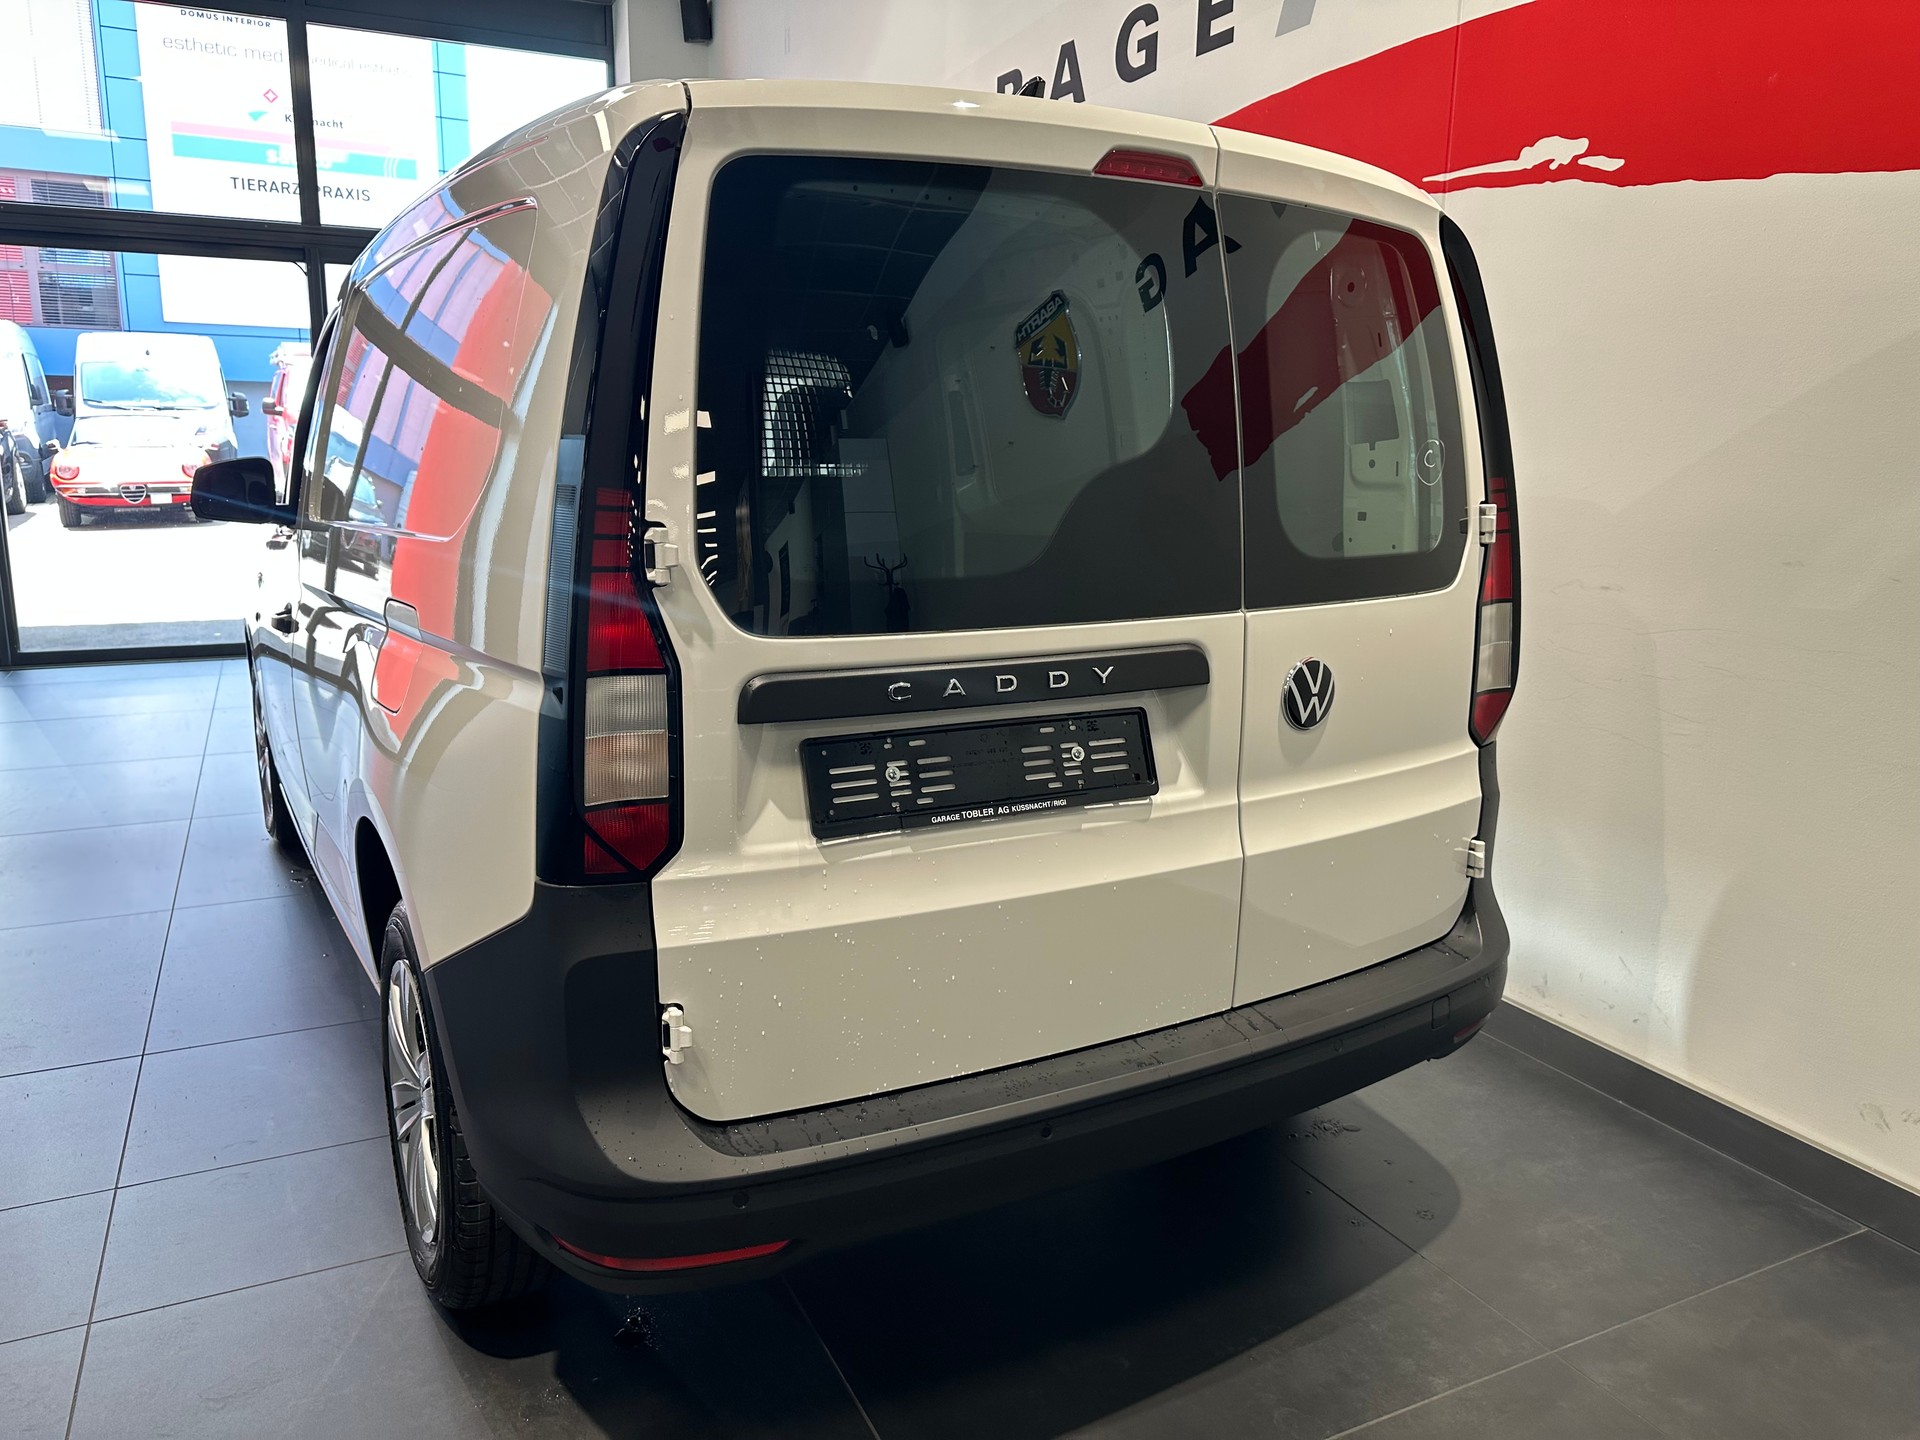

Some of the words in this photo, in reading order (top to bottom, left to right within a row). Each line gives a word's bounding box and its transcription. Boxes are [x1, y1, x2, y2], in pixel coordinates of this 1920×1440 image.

[180, 8, 219, 21] DOMUS
[222, 14, 271, 28] INTERIOR
[162, 34, 237, 58] esthetic
[284, 113, 344, 129] Knacht
[229, 176, 371, 202] TIERARZRAXIS
[887, 665, 1115, 702] CADDY
[931, 812, 961, 824] GARAGE
[961, 807, 995, 819] TOBLER
[997, 805, 1010, 815] AG
